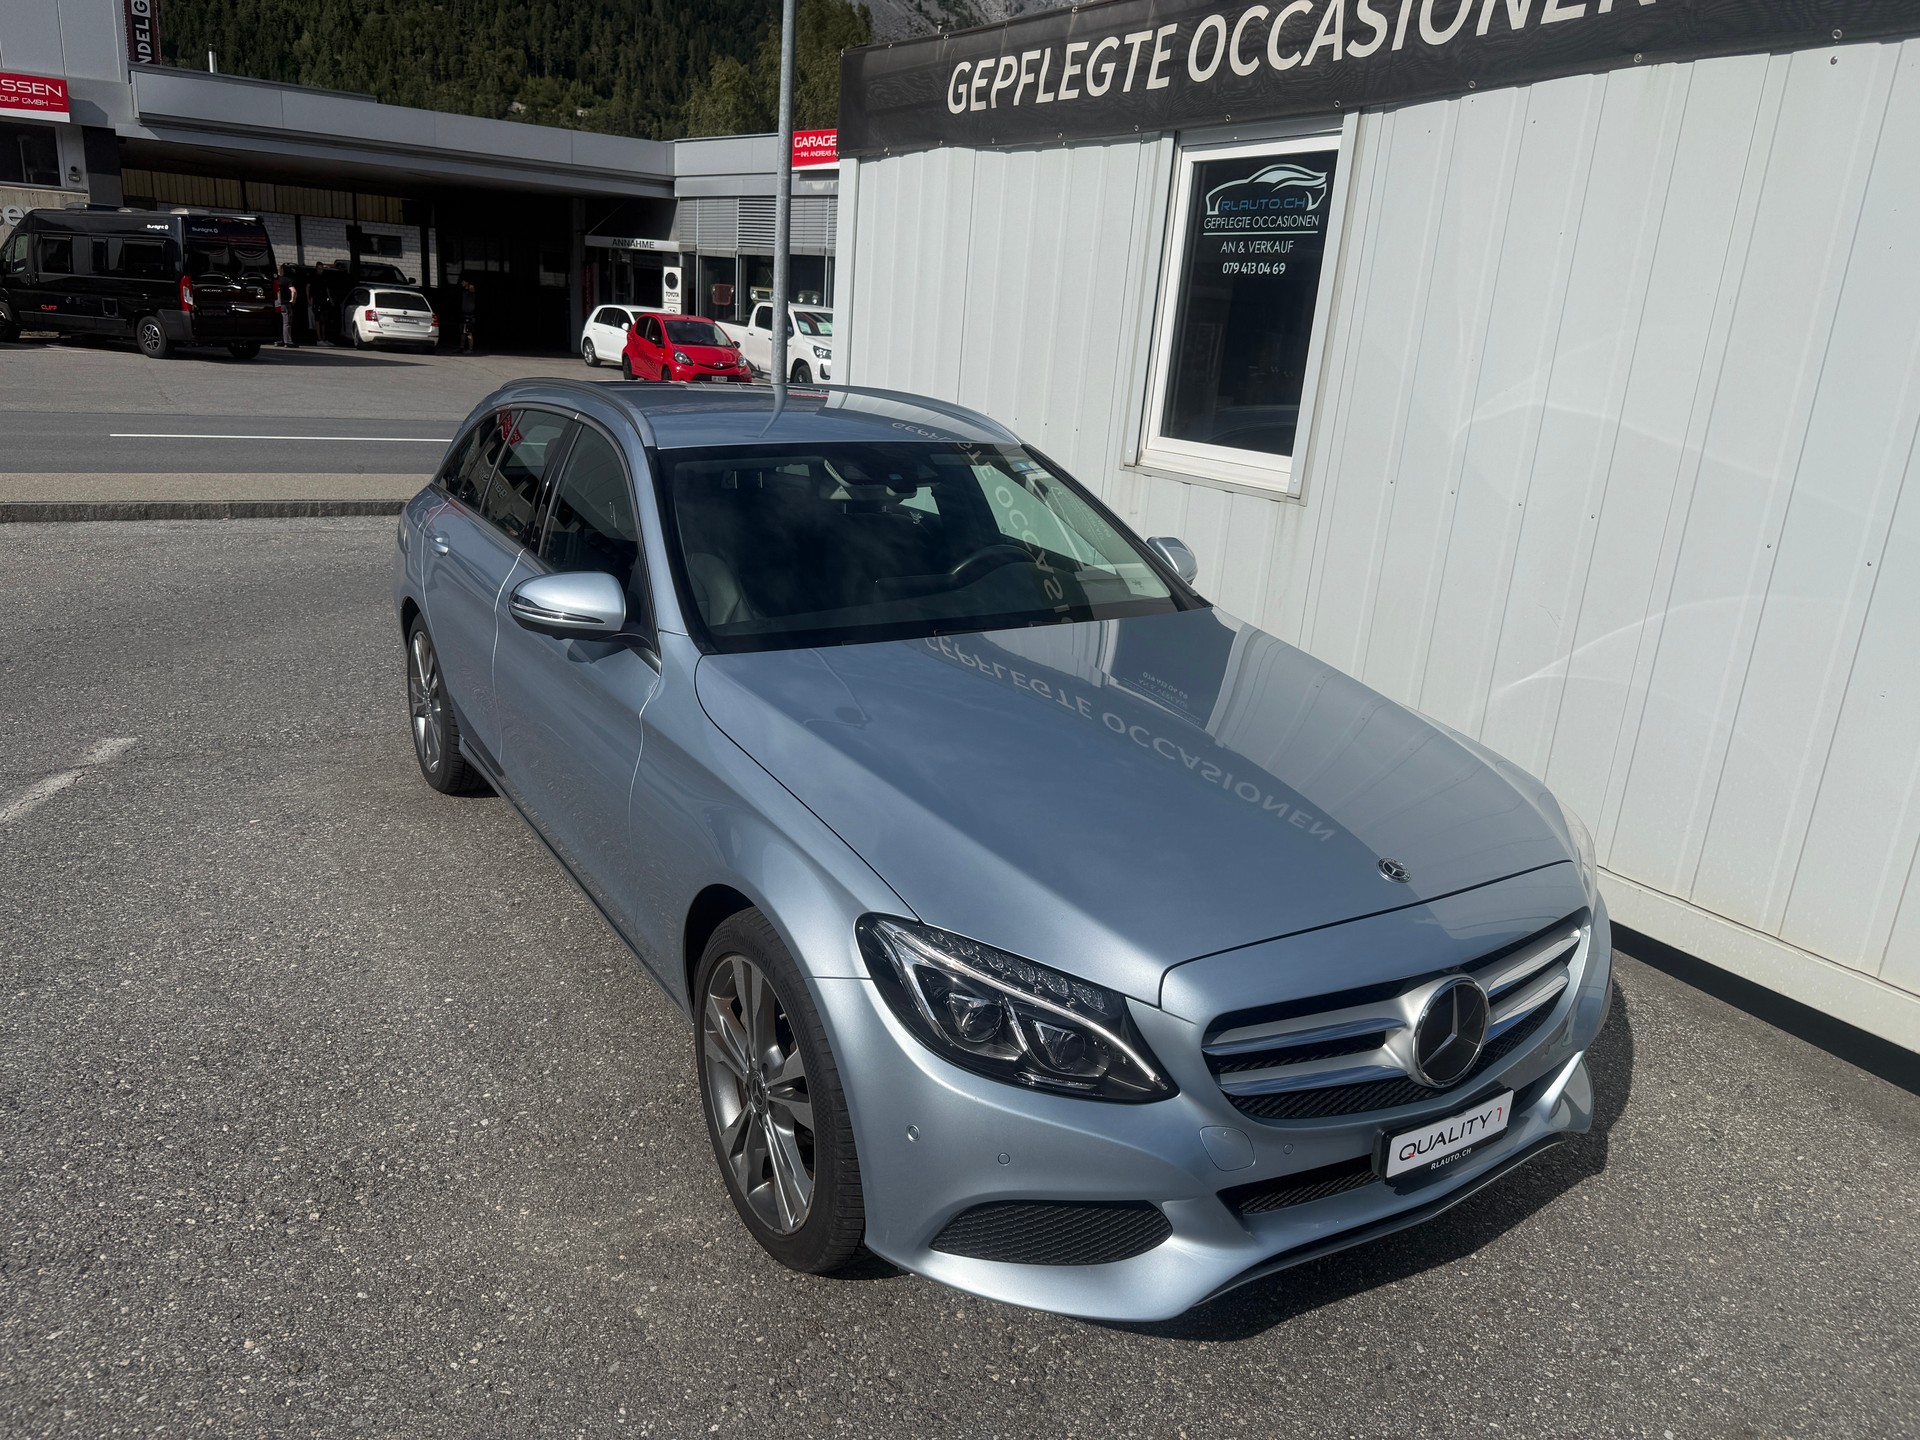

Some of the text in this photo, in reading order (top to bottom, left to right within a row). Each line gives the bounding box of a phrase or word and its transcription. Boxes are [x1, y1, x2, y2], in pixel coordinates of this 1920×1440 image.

[947, 0, 1654, 114] GEPFLEGTE OCCASIO
[794, 134, 838, 148] GARAGE
[1221, 197, 1306, 211] RLAUTO.CH
[1203, 214, 1320, 229] GEPFLEGTE OCCASIONEN
[611, 238, 656, 250] ANNAHME
[1219, 240, 1295, 254] AN & VERKAUF
[1222, 262, 1286, 274] 079 413 04 69
[665, 291, 680, 299] TOYOTA
[1398, 1106, 1503, 1162] QUALITY 1
[1430, 1147, 1473, 1171] RLAUTO.CH
